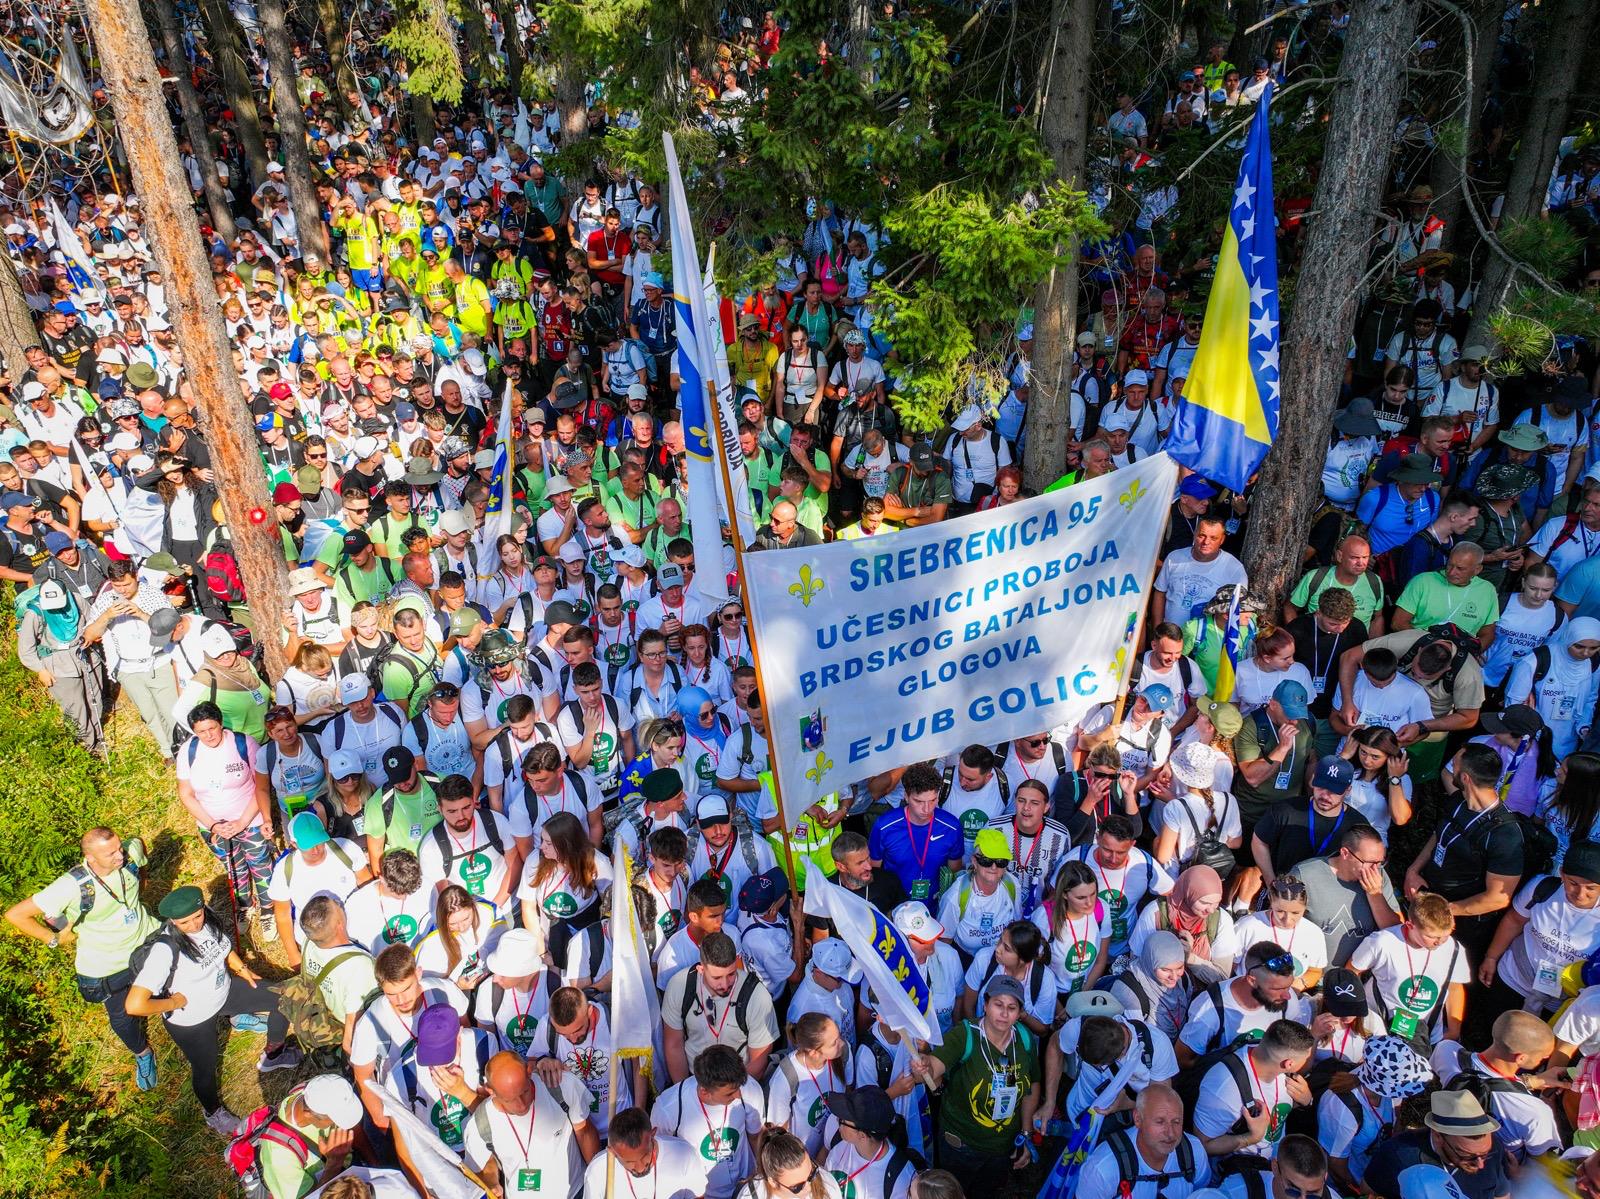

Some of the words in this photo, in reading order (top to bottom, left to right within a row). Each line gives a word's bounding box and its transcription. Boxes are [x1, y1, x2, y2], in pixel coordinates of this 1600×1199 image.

[849, 510, 1058, 592] SREBRENICA
[1066, 495, 1102, 530] 95
[800, 629, 954, 698] BRDSKOG
[964, 573, 1140, 643] BATALJONA
[816, 585, 975, 650] UČESNICI
[983, 539, 1120, 601] PROBOJA
[848, 707, 955, 763] EJUB
[968, 664, 1099, 722] GOLIĆ
[898, 635, 1042, 697] GLOGOVA
[1327, 765, 1339, 778] NY
[1006, 860, 1043, 877] Jeep
